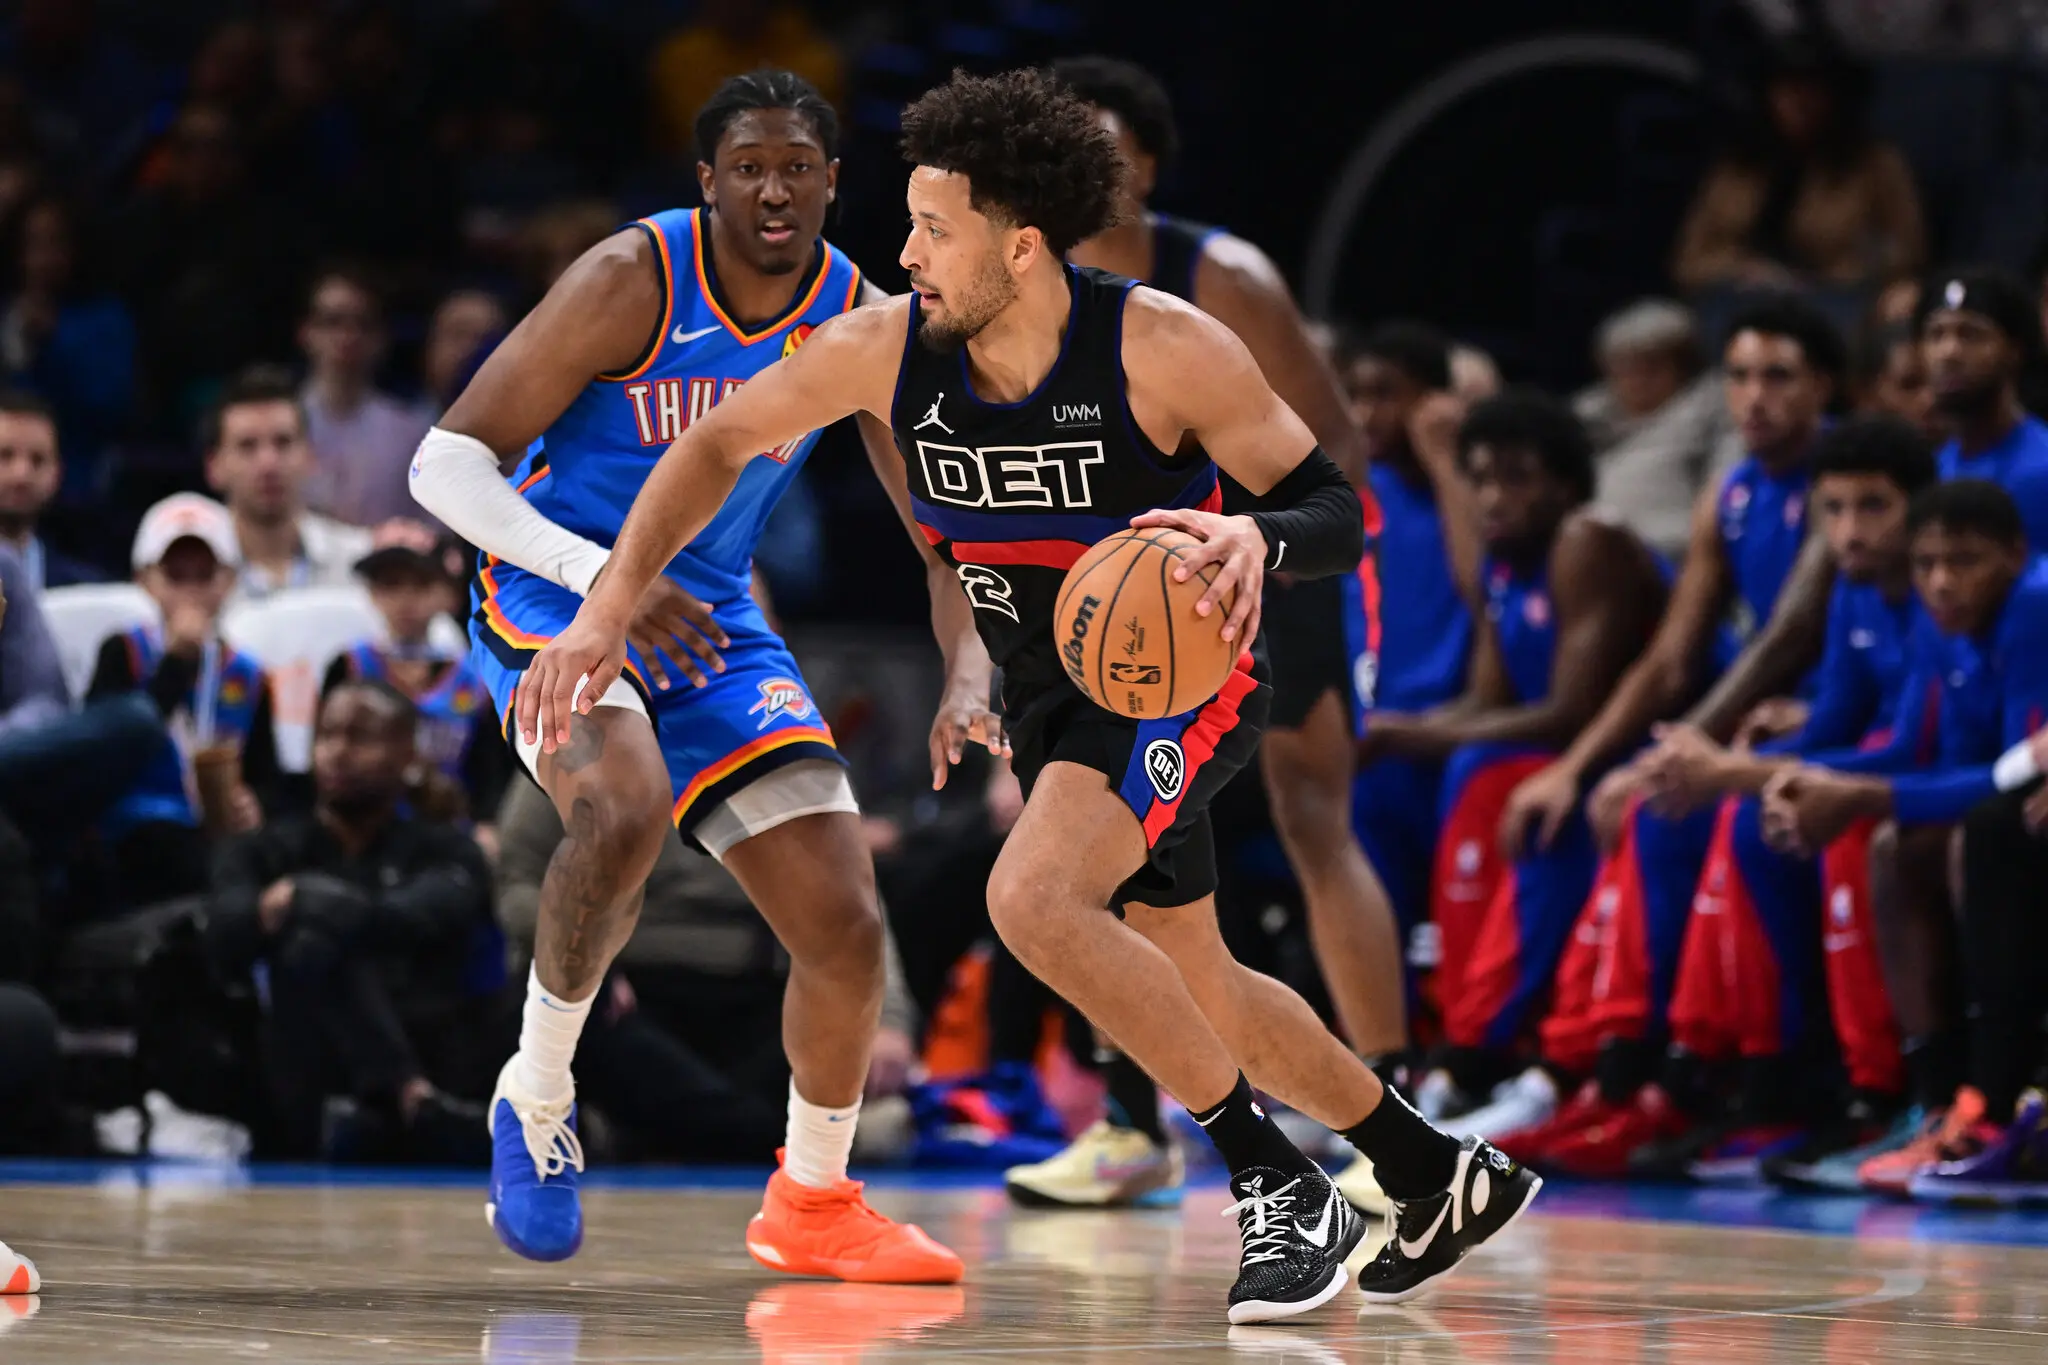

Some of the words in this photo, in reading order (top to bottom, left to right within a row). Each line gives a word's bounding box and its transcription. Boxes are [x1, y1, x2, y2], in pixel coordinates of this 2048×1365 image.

[1053, 403, 1101, 423] UWM
[916, 440, 1104, 508] DET
[957, 564, 1020, 623] 2
[1153, 749, 1180, 788] DET
